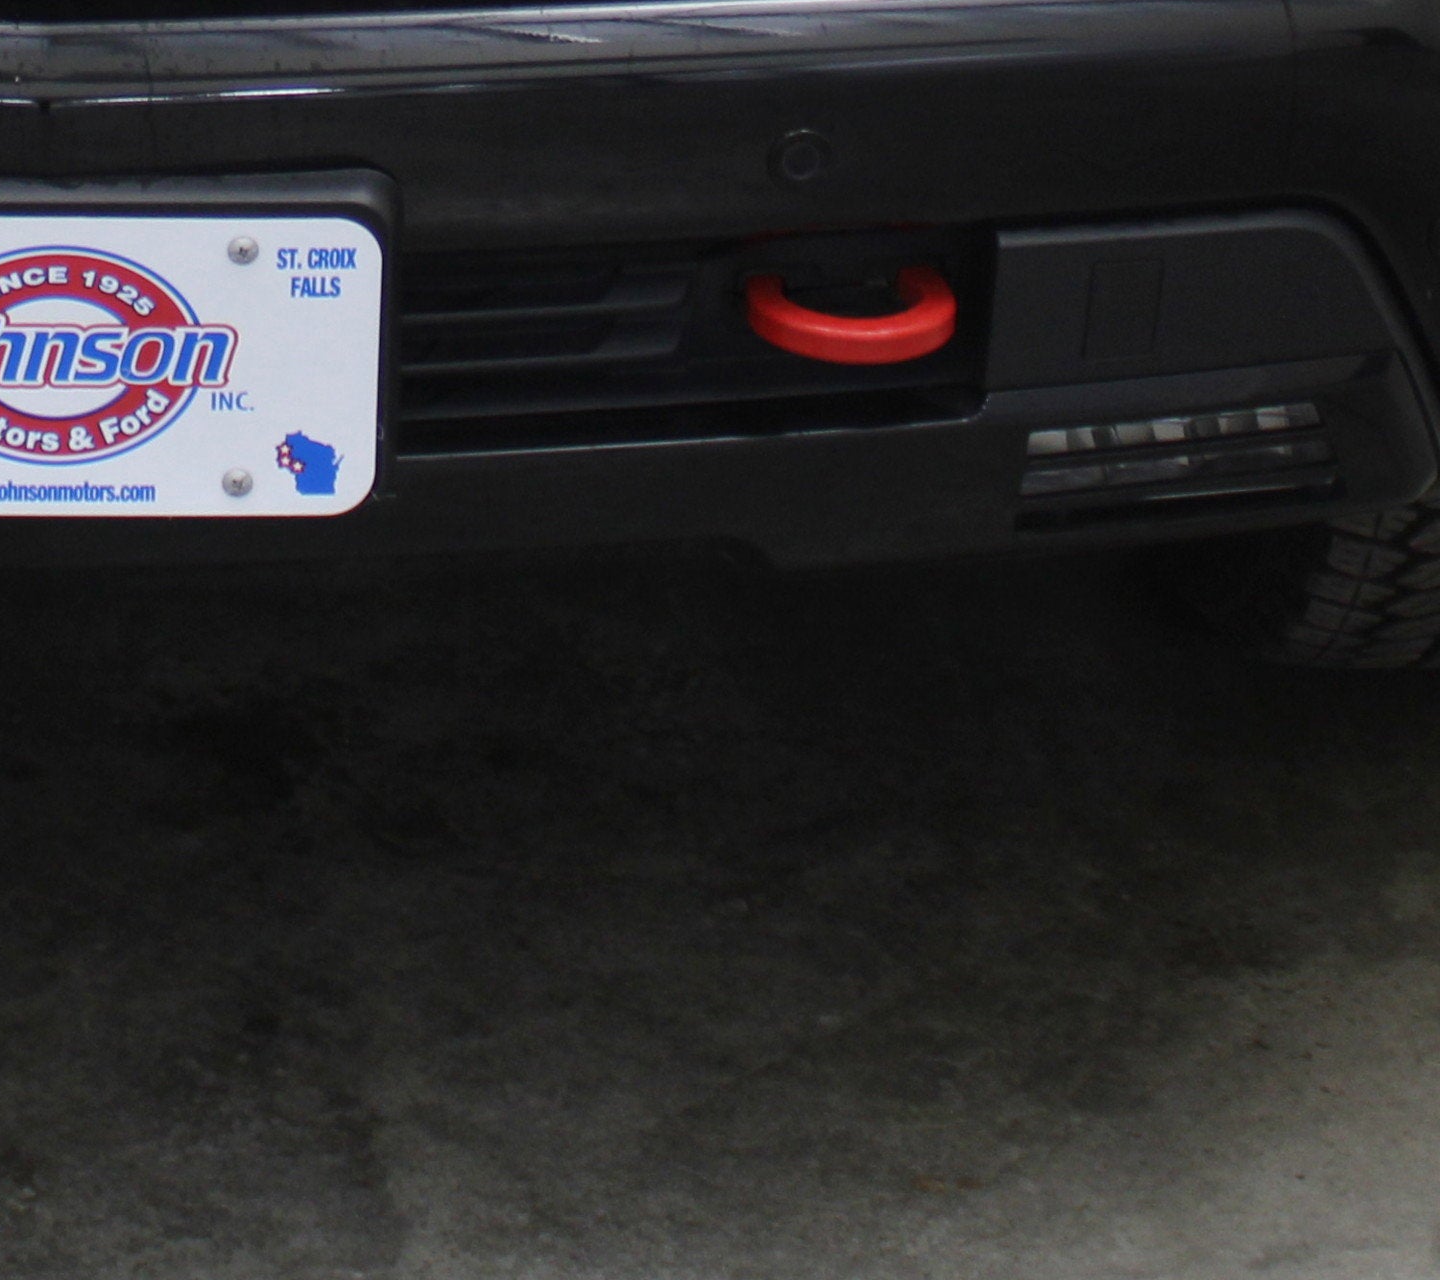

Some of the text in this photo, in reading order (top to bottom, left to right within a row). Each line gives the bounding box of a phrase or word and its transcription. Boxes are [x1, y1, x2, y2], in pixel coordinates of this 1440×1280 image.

[276, 248, 357, 270] ST. CROIX
[81, 268, 156, 317] 1925
[290, 276, 341, 298] FALLS
[210, 391, 255, 412] INC.
[68, 426, 95, 452] &
[98, 390, 171, 445] Ford
